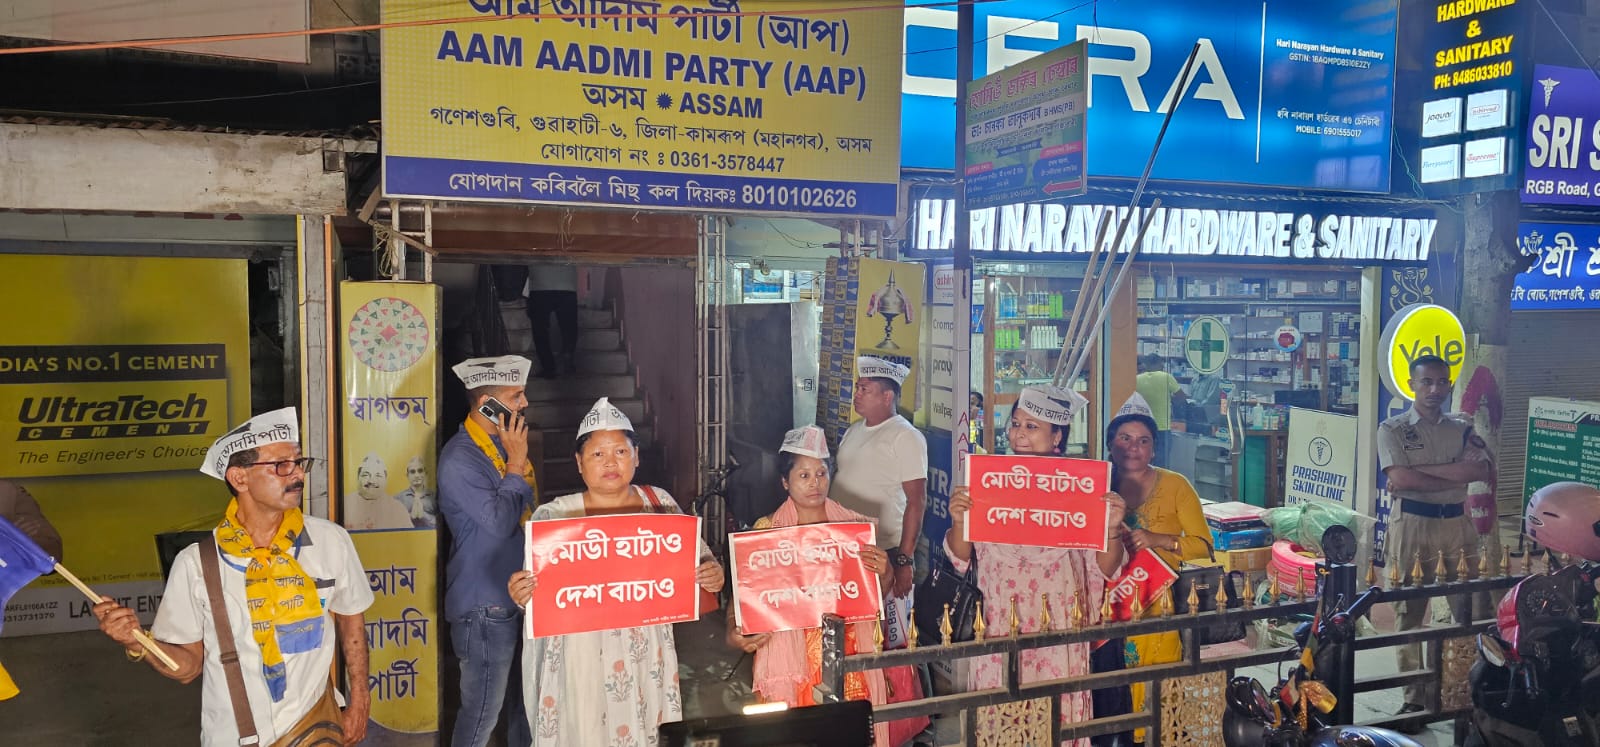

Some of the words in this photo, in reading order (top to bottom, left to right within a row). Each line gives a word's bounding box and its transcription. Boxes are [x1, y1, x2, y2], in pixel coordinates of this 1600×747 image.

[1466, 20, 1482, 38] &
[1276, 38, 1291, 49] Hari
[1292, 40, 1319, 54] Narayan
[1320, 44, 1351, 56] Hardware
[1358, 49, 1384, 60] Sanitary
[1289, 52, 1310, 62] GSTIN:
[1435, 35, 1514, 68] SANITARY
[436, 30, 523, 67] AAM
[535, 40, 652, 78] AADMI
[665, 52, 773, 89] PARTY
[784, 60, 866, 101] (AAP)
[902, 6, 1246, 120] CERA
[1434, 74, 1451, 90] PH:
[1452, 60, 1513, 87] 8486033810
[582, 83, 648, 110] অসম
[679, 92, 763, 119] ASSAM
[836, 136, 872, 153] অসম
[1529, 114, 1583, 169] SRI
[541, 142, 622, 164] যোগাযোগ
[629, 150, 650, 166] নং
[670, 150, 785, 173] 0361-3578447
[449, 172, 523, 193] যোগদান
[648, 183, 680, 201] কল
[742, 185, 857, 208] 8010102626
[1526, 180, 1554, 194] RGB
[1557, 181, 1590, 198] Road,
[913, 199, 998, 250] HARI
[1000, 203, 1141, 254] NARAYAN
[1142, 208, 1294, 258] HARDWARE
[1294, 214, 1316, 259] &
[1318, 214, 1438, 261] SANITARY
[68, 352, 120, 371] NO.1
[128, 355, 218, 370] CEMENT
[18, 393, 208, 424] UltraTech
[28, 423, 200, 439] CEMENT
[18, 451, 49, 464] The
[56, 448, 145, 465] Engineer's
[152, 446, 208, 460] Choice
[1036, 469, 1095, 494] হাটাও
[1292, 465, 1347, 488] PRASHANTI
[1292, 479, 1315, 497] SKIN
[1315, 484, 1346, 502] CLINIC
[987, 507, 1026, 525] দেশ
[1030, 508, 1087, 528] বাচাও
[613, 527, 682, 559] হাটাও
[364, 565, 417, 596] আম
[555, 583, 605, 609] দেশ
[607, 577, 675, 603] বাচাও
[889, 626, 898, 642] Go
